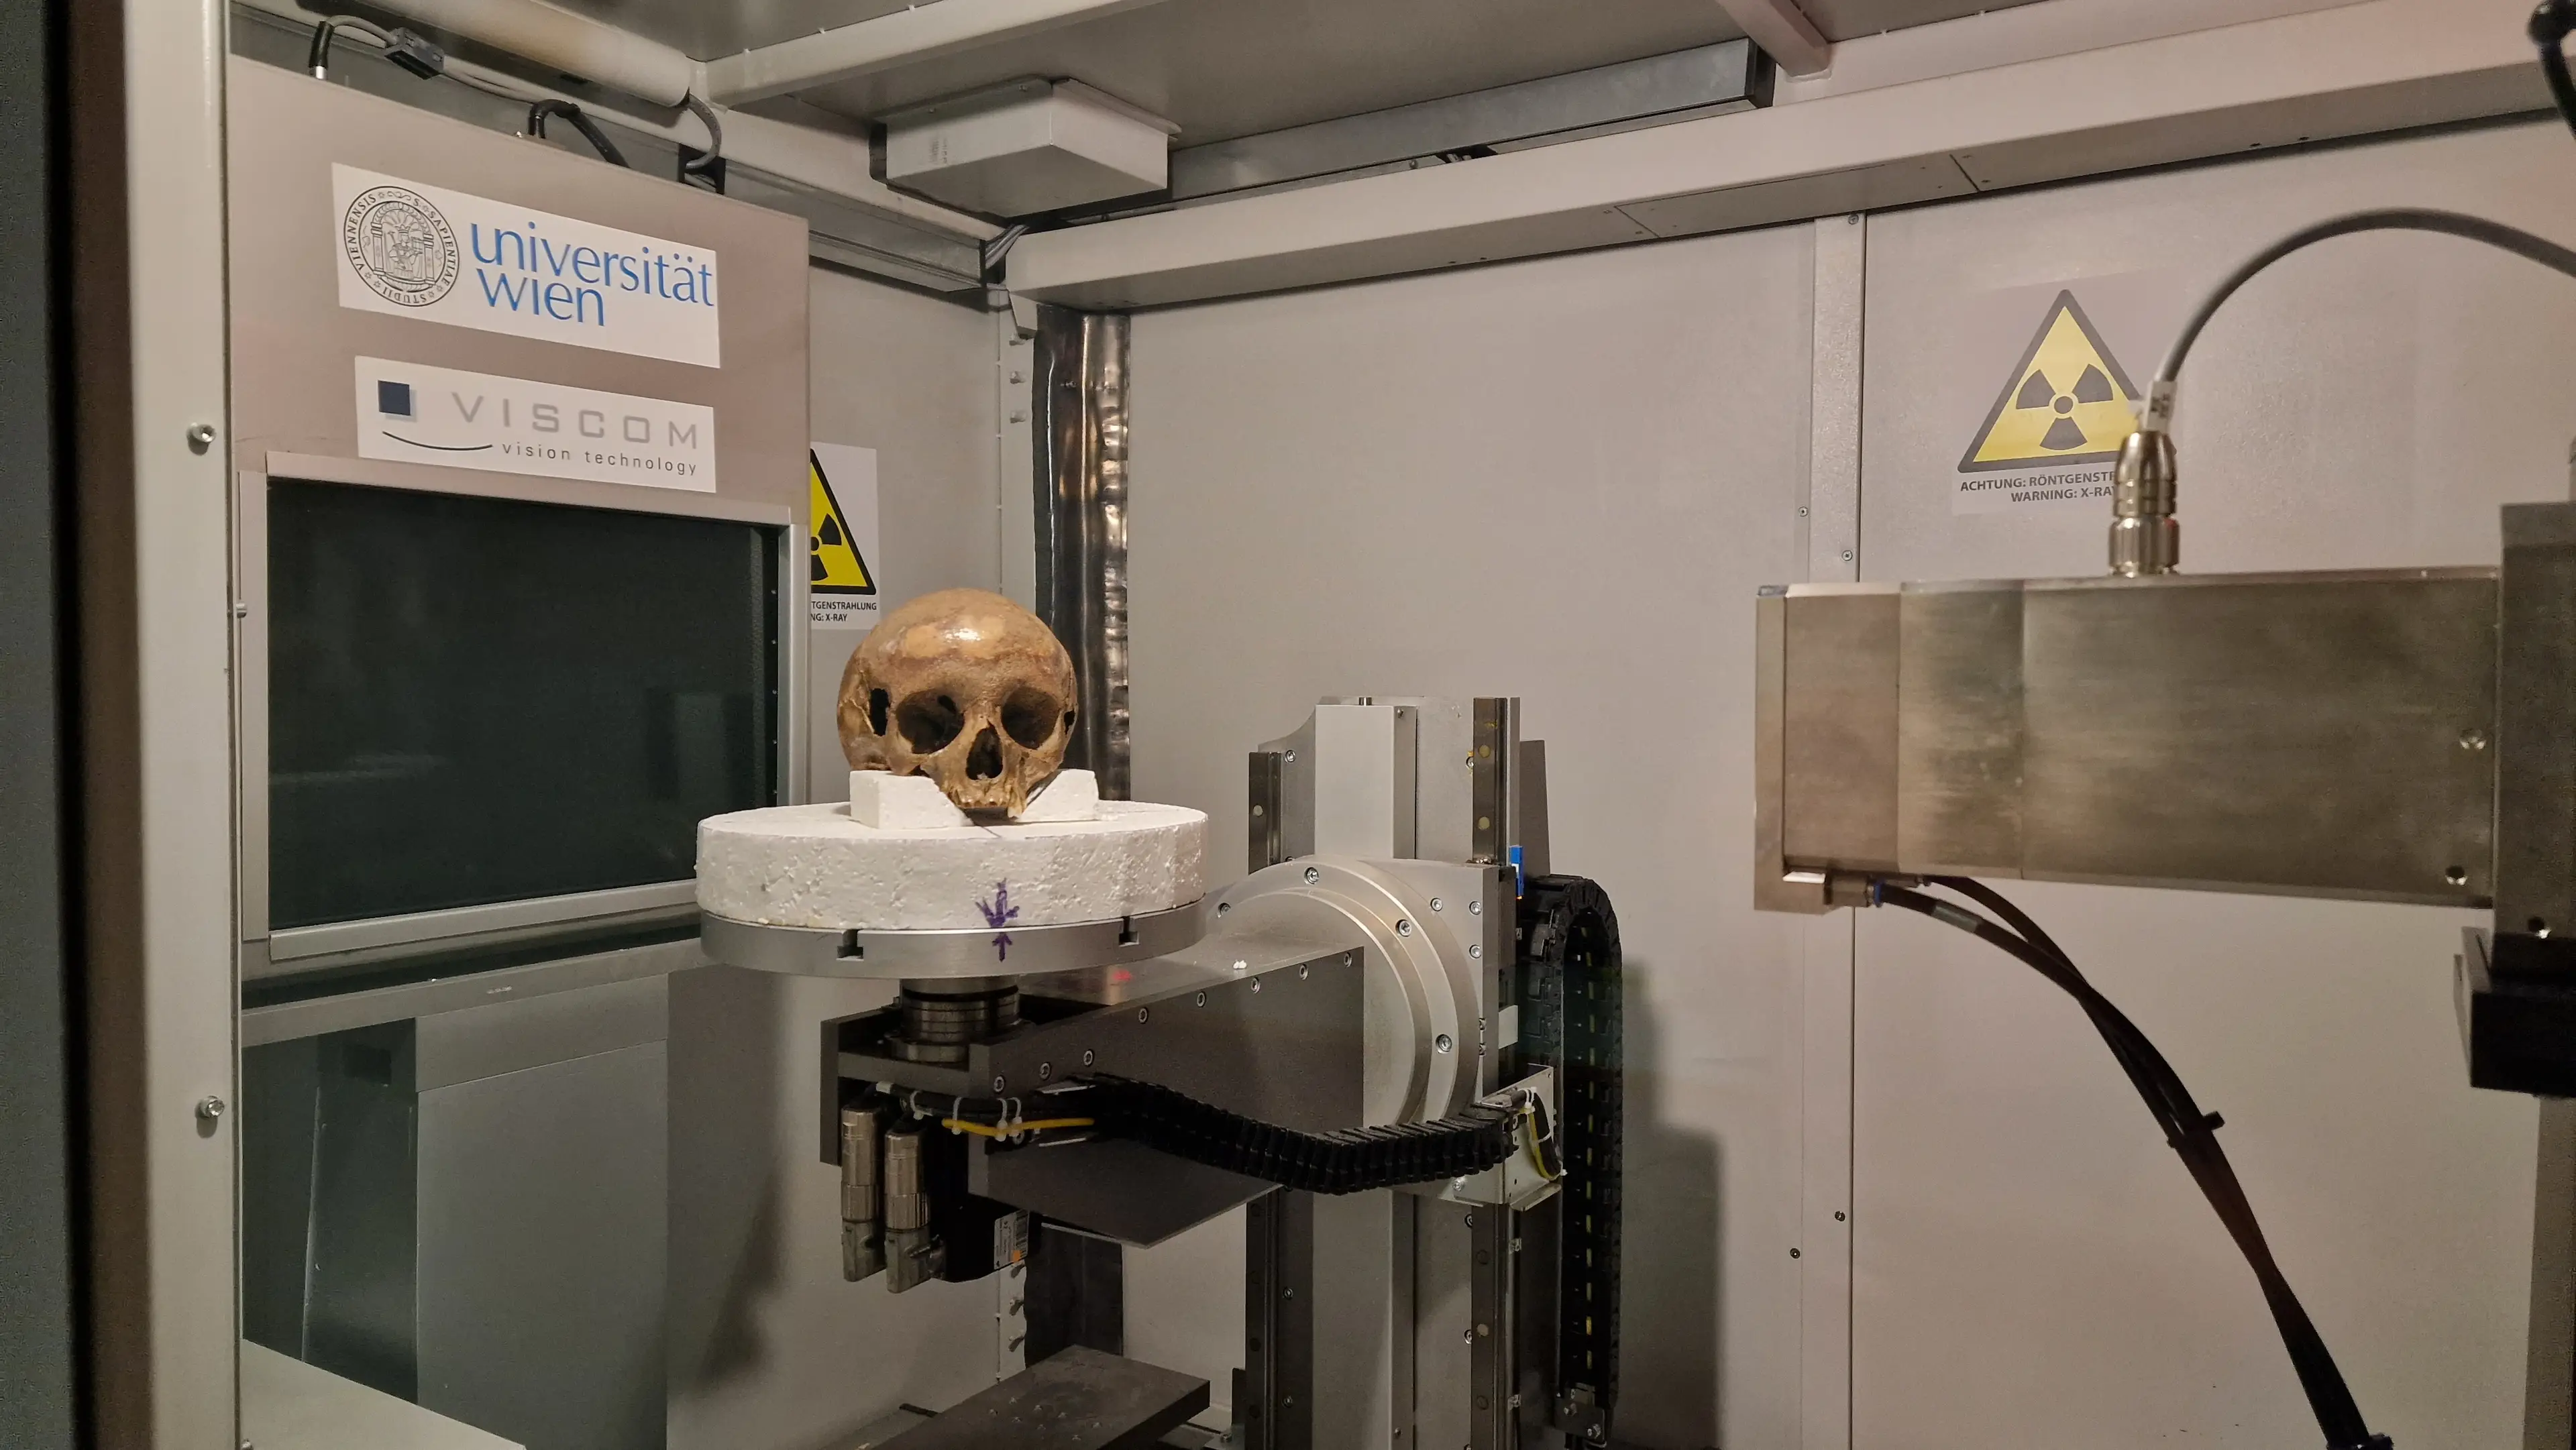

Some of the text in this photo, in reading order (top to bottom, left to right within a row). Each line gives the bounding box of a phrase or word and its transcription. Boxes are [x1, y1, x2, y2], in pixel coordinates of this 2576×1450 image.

[347, 194, 376, 270] VIENNENSIS
[428, 211, 456, 286] SAPIENTIAE
[471, 221, 714, 306] universität
[382, 286, 427, 304] STUDII
[476, 268, 604, 327] wien
[451, 392, 697, 449] VISCOM
[502, 442, 696, 476] vision technology
[1960, 471, 2115, 492] ACHTUNG: RÖNTGENST
[2010, 488, 2078, 502] WARNING:
[811, 601, 877, 610] TGENSTRAHLUNG
[826, 613, 847, 622] X-RAY
